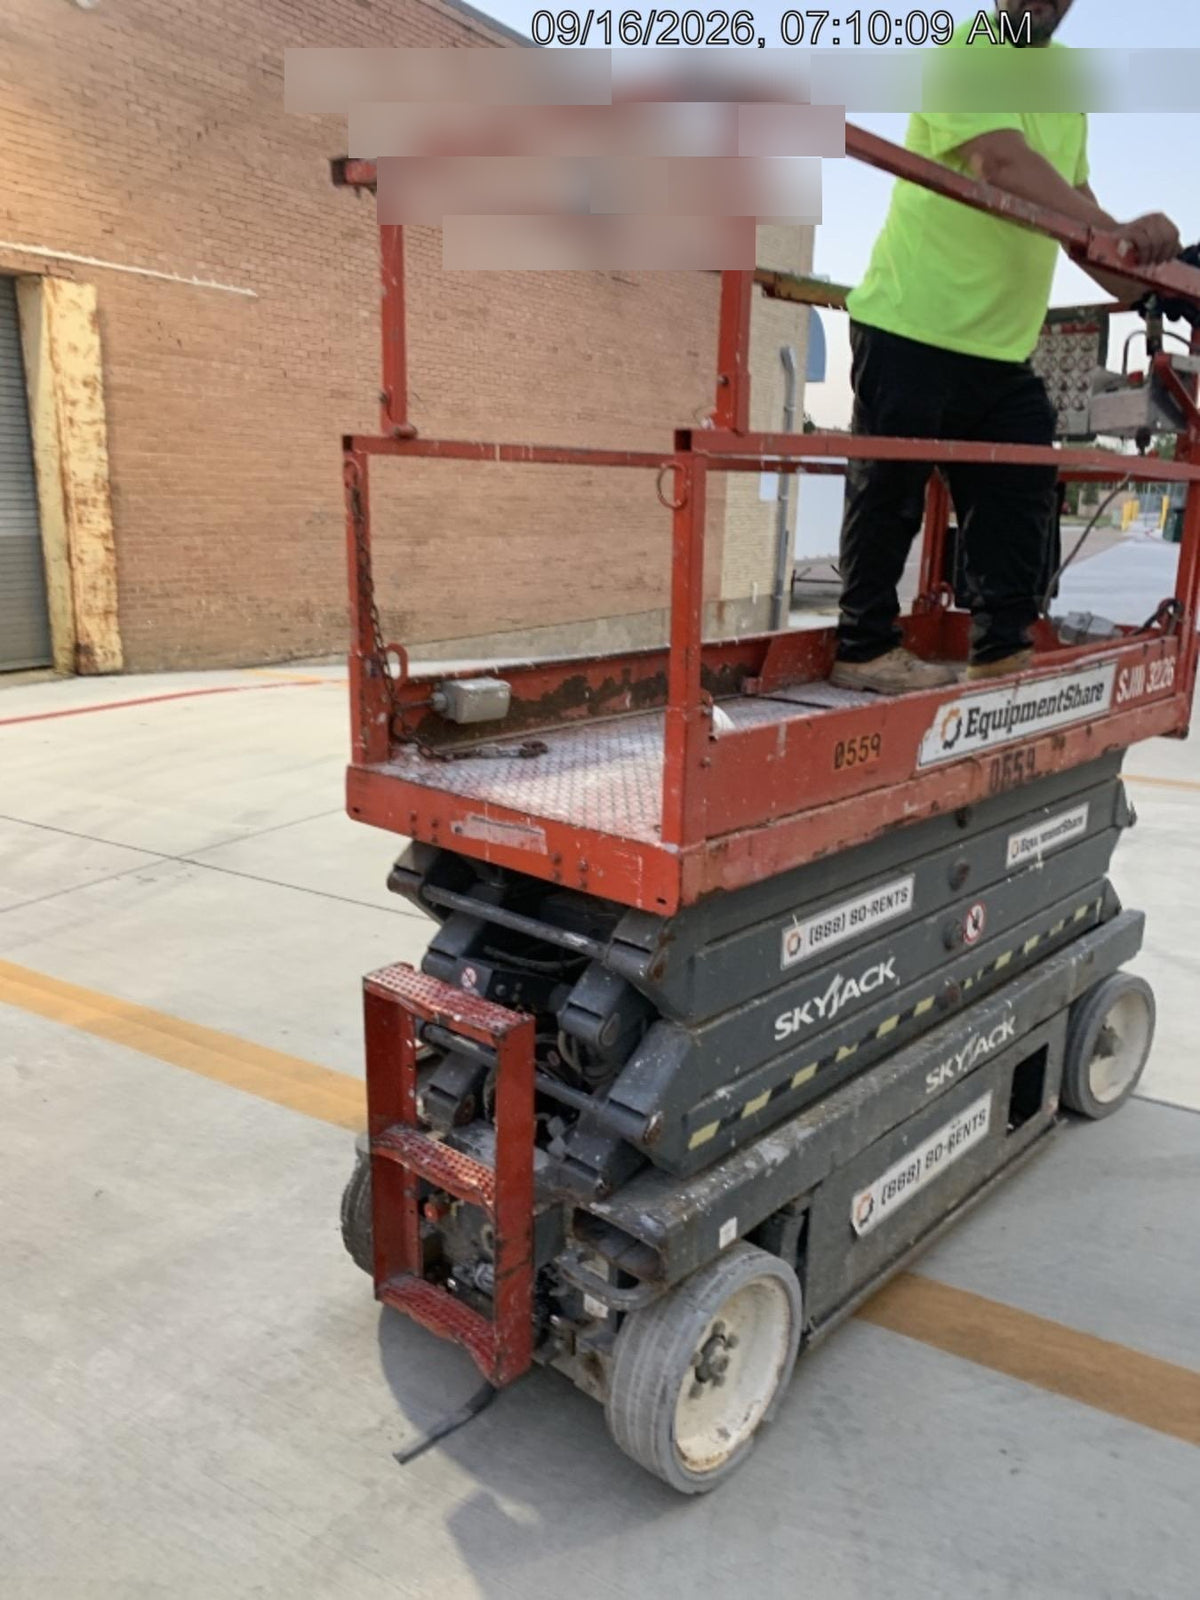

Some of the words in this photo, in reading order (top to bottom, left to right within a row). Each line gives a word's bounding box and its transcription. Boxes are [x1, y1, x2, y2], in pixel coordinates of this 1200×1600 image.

[964, 682, 1104, 740] EquipmentShare
[834, 732, 881, 770] 0559
[849, 886, 909, 926] 80-RENTS
[774, 956, 896, 1041] SKYJACK
[925, 1015, 1016, 1094] SKYJACK
[925, 1107, 987, 1169] 80-RENTS
